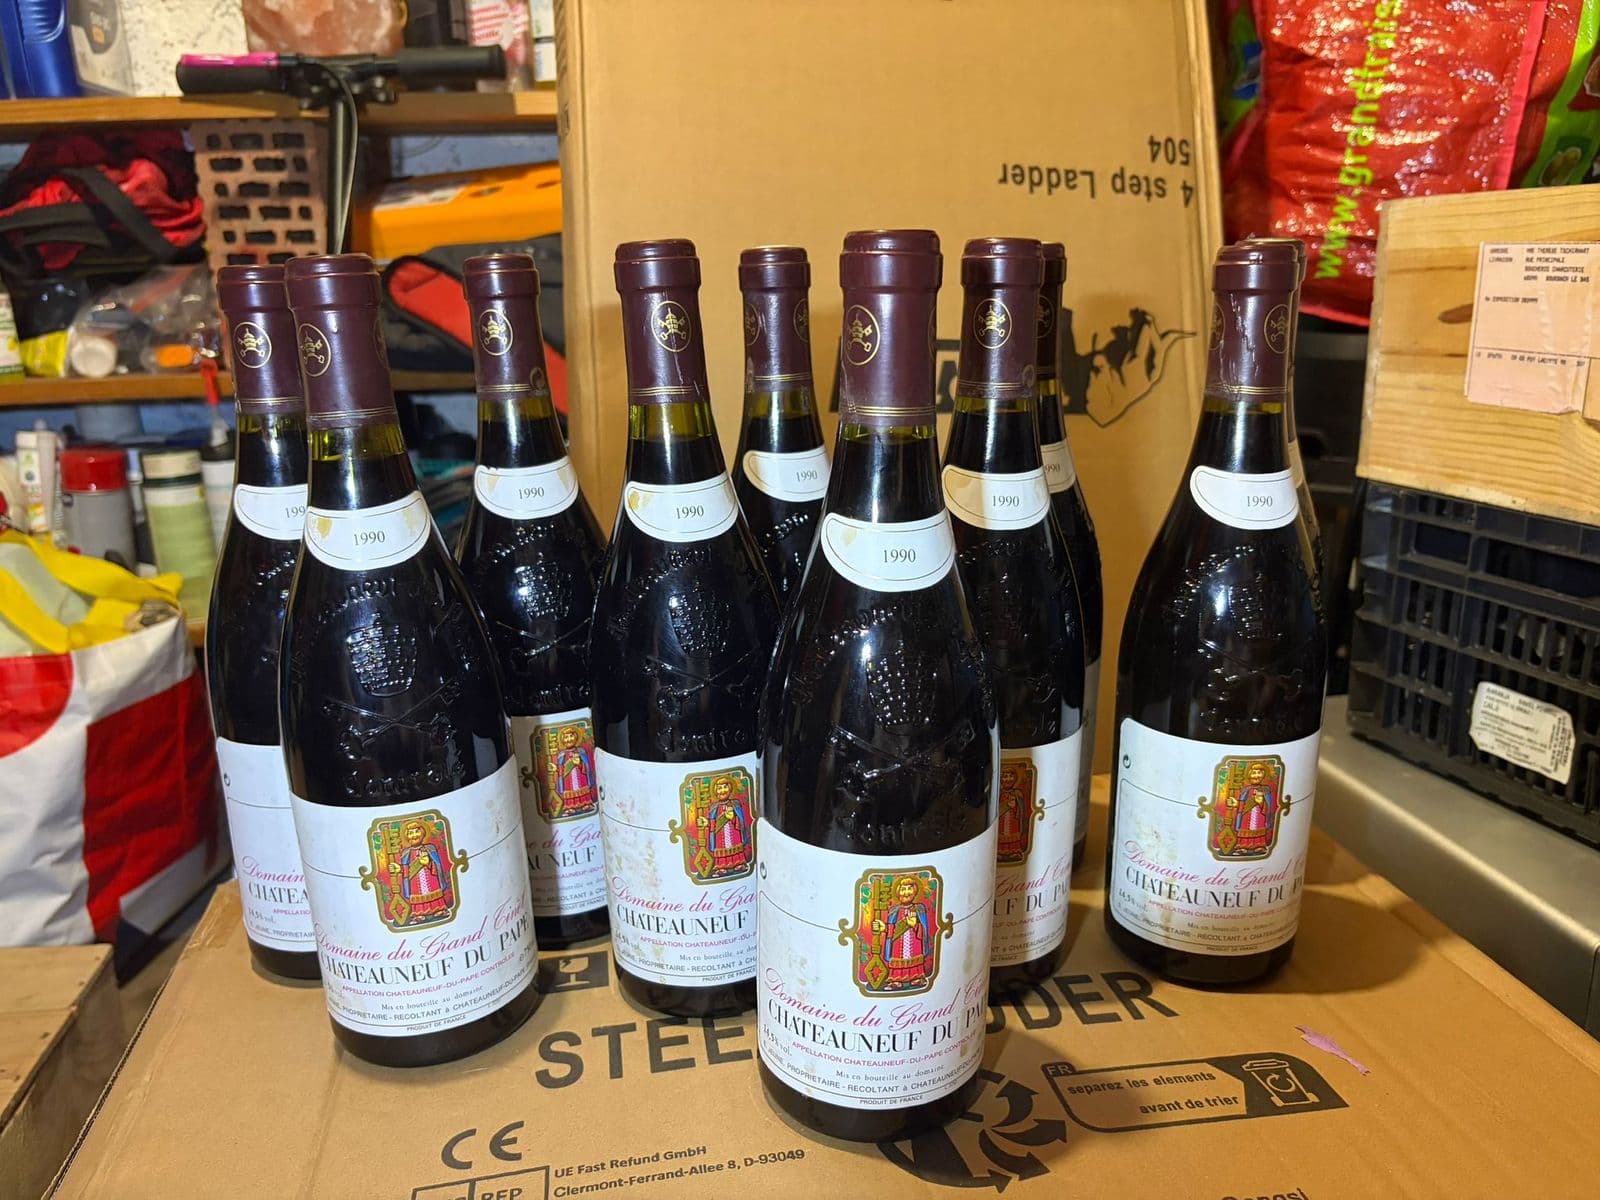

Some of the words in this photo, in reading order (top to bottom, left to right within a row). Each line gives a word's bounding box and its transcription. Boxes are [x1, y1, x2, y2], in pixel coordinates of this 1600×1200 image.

[1148, 135, 1190, 167] 504
[998, 163, 1095, 199] Ladder
[1111, 166, 1167, 202] step
[1180, 180, 1194, 208] 4
[795, 469, 818, 482] 1990
[1043, 463, 1061, 473] 990
[518, 487, 545, 499] 1990
[992, 495, 1020, 507] 1990
[1246, 495, 1273, 507] 1990
[285, 506, 307, 518] 199
[675, 504, 705, 520] 1990
[353, 530, 386, 546] 1990
[882, 548, 917, 563] 1990
[569, 824, 603, 848] Gra
[243, 856, 304, 882] Domain
[1122, 840, 1199, 881] Domaine
[1204, 867, 1229, 886] du
[1234, 858, 1293, 889] Grand
[248, 881, 309, 904] CHATEA
[612, 876, 684, 912] Domaine
[688, 891, 714, 913] du
[720, 885, 757, 913] Gra
[1126, 866, 1260, 908] CHATEAUNEUF
[1267, 884, 1286, 904] DU
[272, 908, 311, 916] APPELLATIO
[1026, 892, 1047, 912] DU
[617, 904, 748, 935] CHATEAUNEUF
[315, 922, 382, 960] Domaine
[387, 939, 414, 960] du
[420, 915, 488, 960] Grand
[321, 952, 454, 985] CHATEAUNEUF
[464, 941, 492, 969] DU
[500, 911, 531, 951] PAPE
[640, 936, 684, 948] APPELLATION
[638, 958, 686, 972] PROPRIETAIRE
[691, 961, 736, 973] RECOLTANT
[342, 985, 385, 997] APPELLATION
[386, 973, 479, 998] CHATEAUNEUF-DU-PAPE
[764, 967, 847, 1022] Domaine
[852, 1005, 882, 1027] du
[888, 988, 961, 1031] Grand
[394, 1009, 441, 1021] RECOLTANT
[443, 1014, 466, 1026] FRANCE
[768, 999, 922, 1053] CHATEAUNEUF
[932, 1016, 959, 1045] DU
[535, 1014, 753, 1089] STEE
[792, 1042, 842, 1063] APPELLATION
[843, 1051, 944, 1067] CHATEAUNEUF-DU-PAPE
[787, 1062, 840, 1088] PROPRIETAIRE
[847, 1083, 899, 1094] RECOLTANT
[836, 1070, 850, 1079] Mis
[864, 1072, 898, 1081] bouteille
[915, 1064, 945, 1077] domaine
[1047, 1064, 1073, 1076] FR
[1068, 1080, 1123, 1096] separez
[1127, 1079, 1149, 1089] les
[1153, 1071, 1217, 1086] elements
[859, 1097, 887, 1106] PRODUIT
[889, 1097, 898, 1105] DE
[899, 1095, 923, 1105] FRANCE
[1139, 1100, 1183, 1114] avant
[1185, 1098, 1204, 1109] de
[1205, 1095, 1239, 1107] trier
[554, 1167, 573, 1178] UE
[577, 1161, 606, 1175] Fast
[610, 1153, 660, 1169] Refund
[664, 1145, 707, 1160] GmbH
[554, 1163, 724, 1198] Clermont-Ferrand-Allee
[727, 1159, 741, 1170] 8,
[744, 1149, 805, 1167] D-93049
